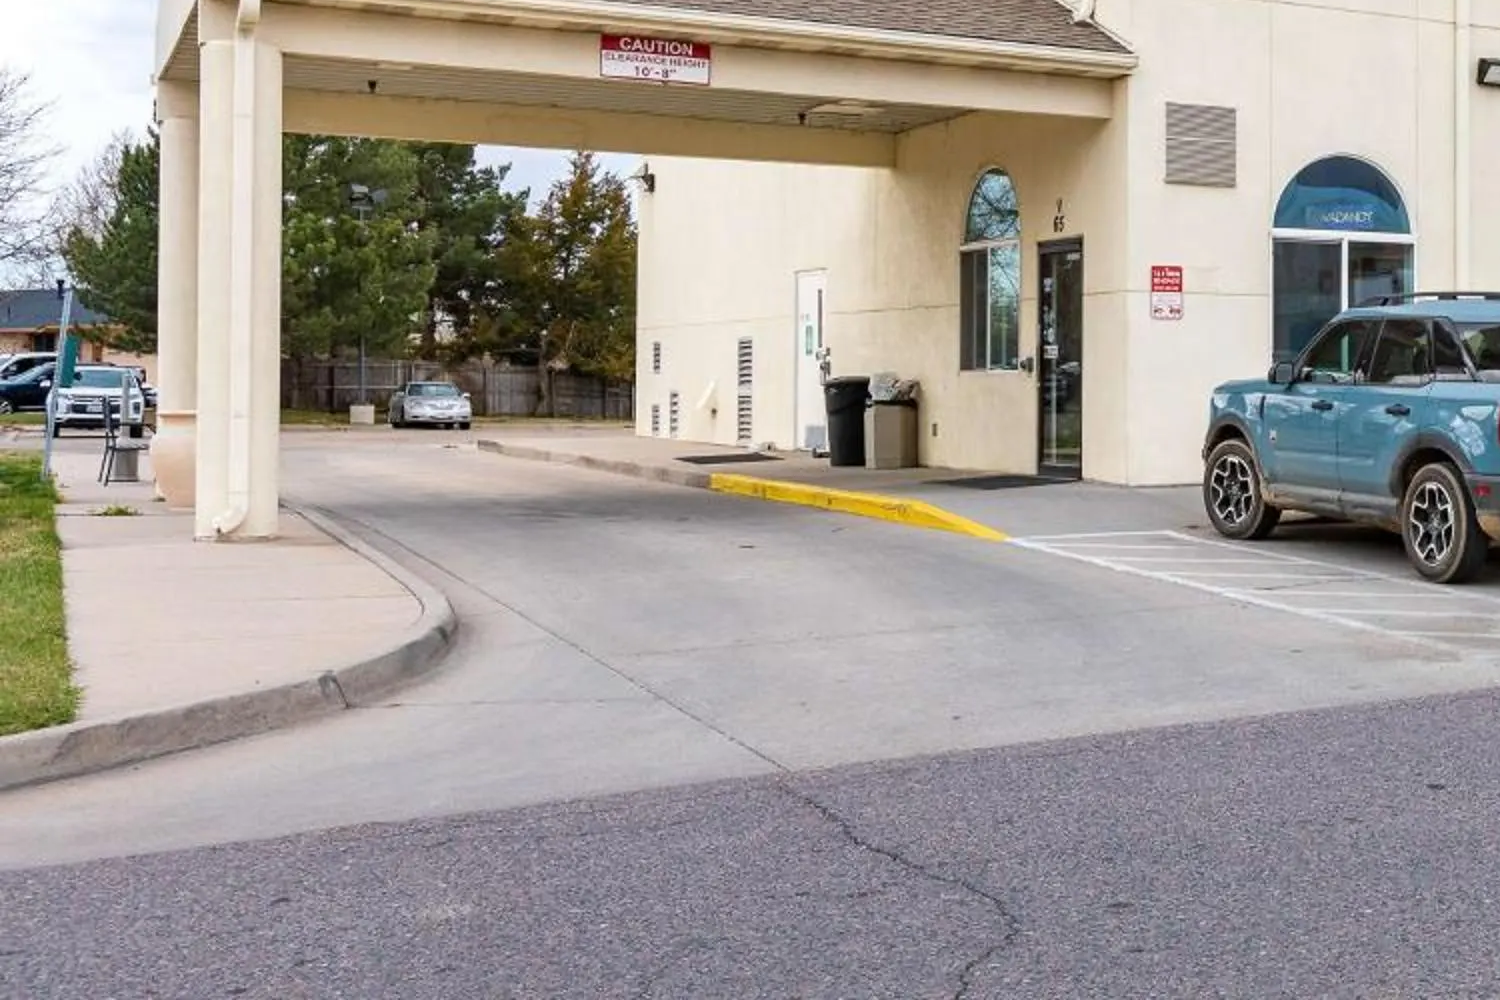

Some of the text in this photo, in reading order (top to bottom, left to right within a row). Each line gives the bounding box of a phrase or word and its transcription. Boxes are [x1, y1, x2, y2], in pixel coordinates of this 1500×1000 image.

[619, 37, 693, 57] CAUTION
[604, 52, 706, 69] CLEARANCE HEIGHT
